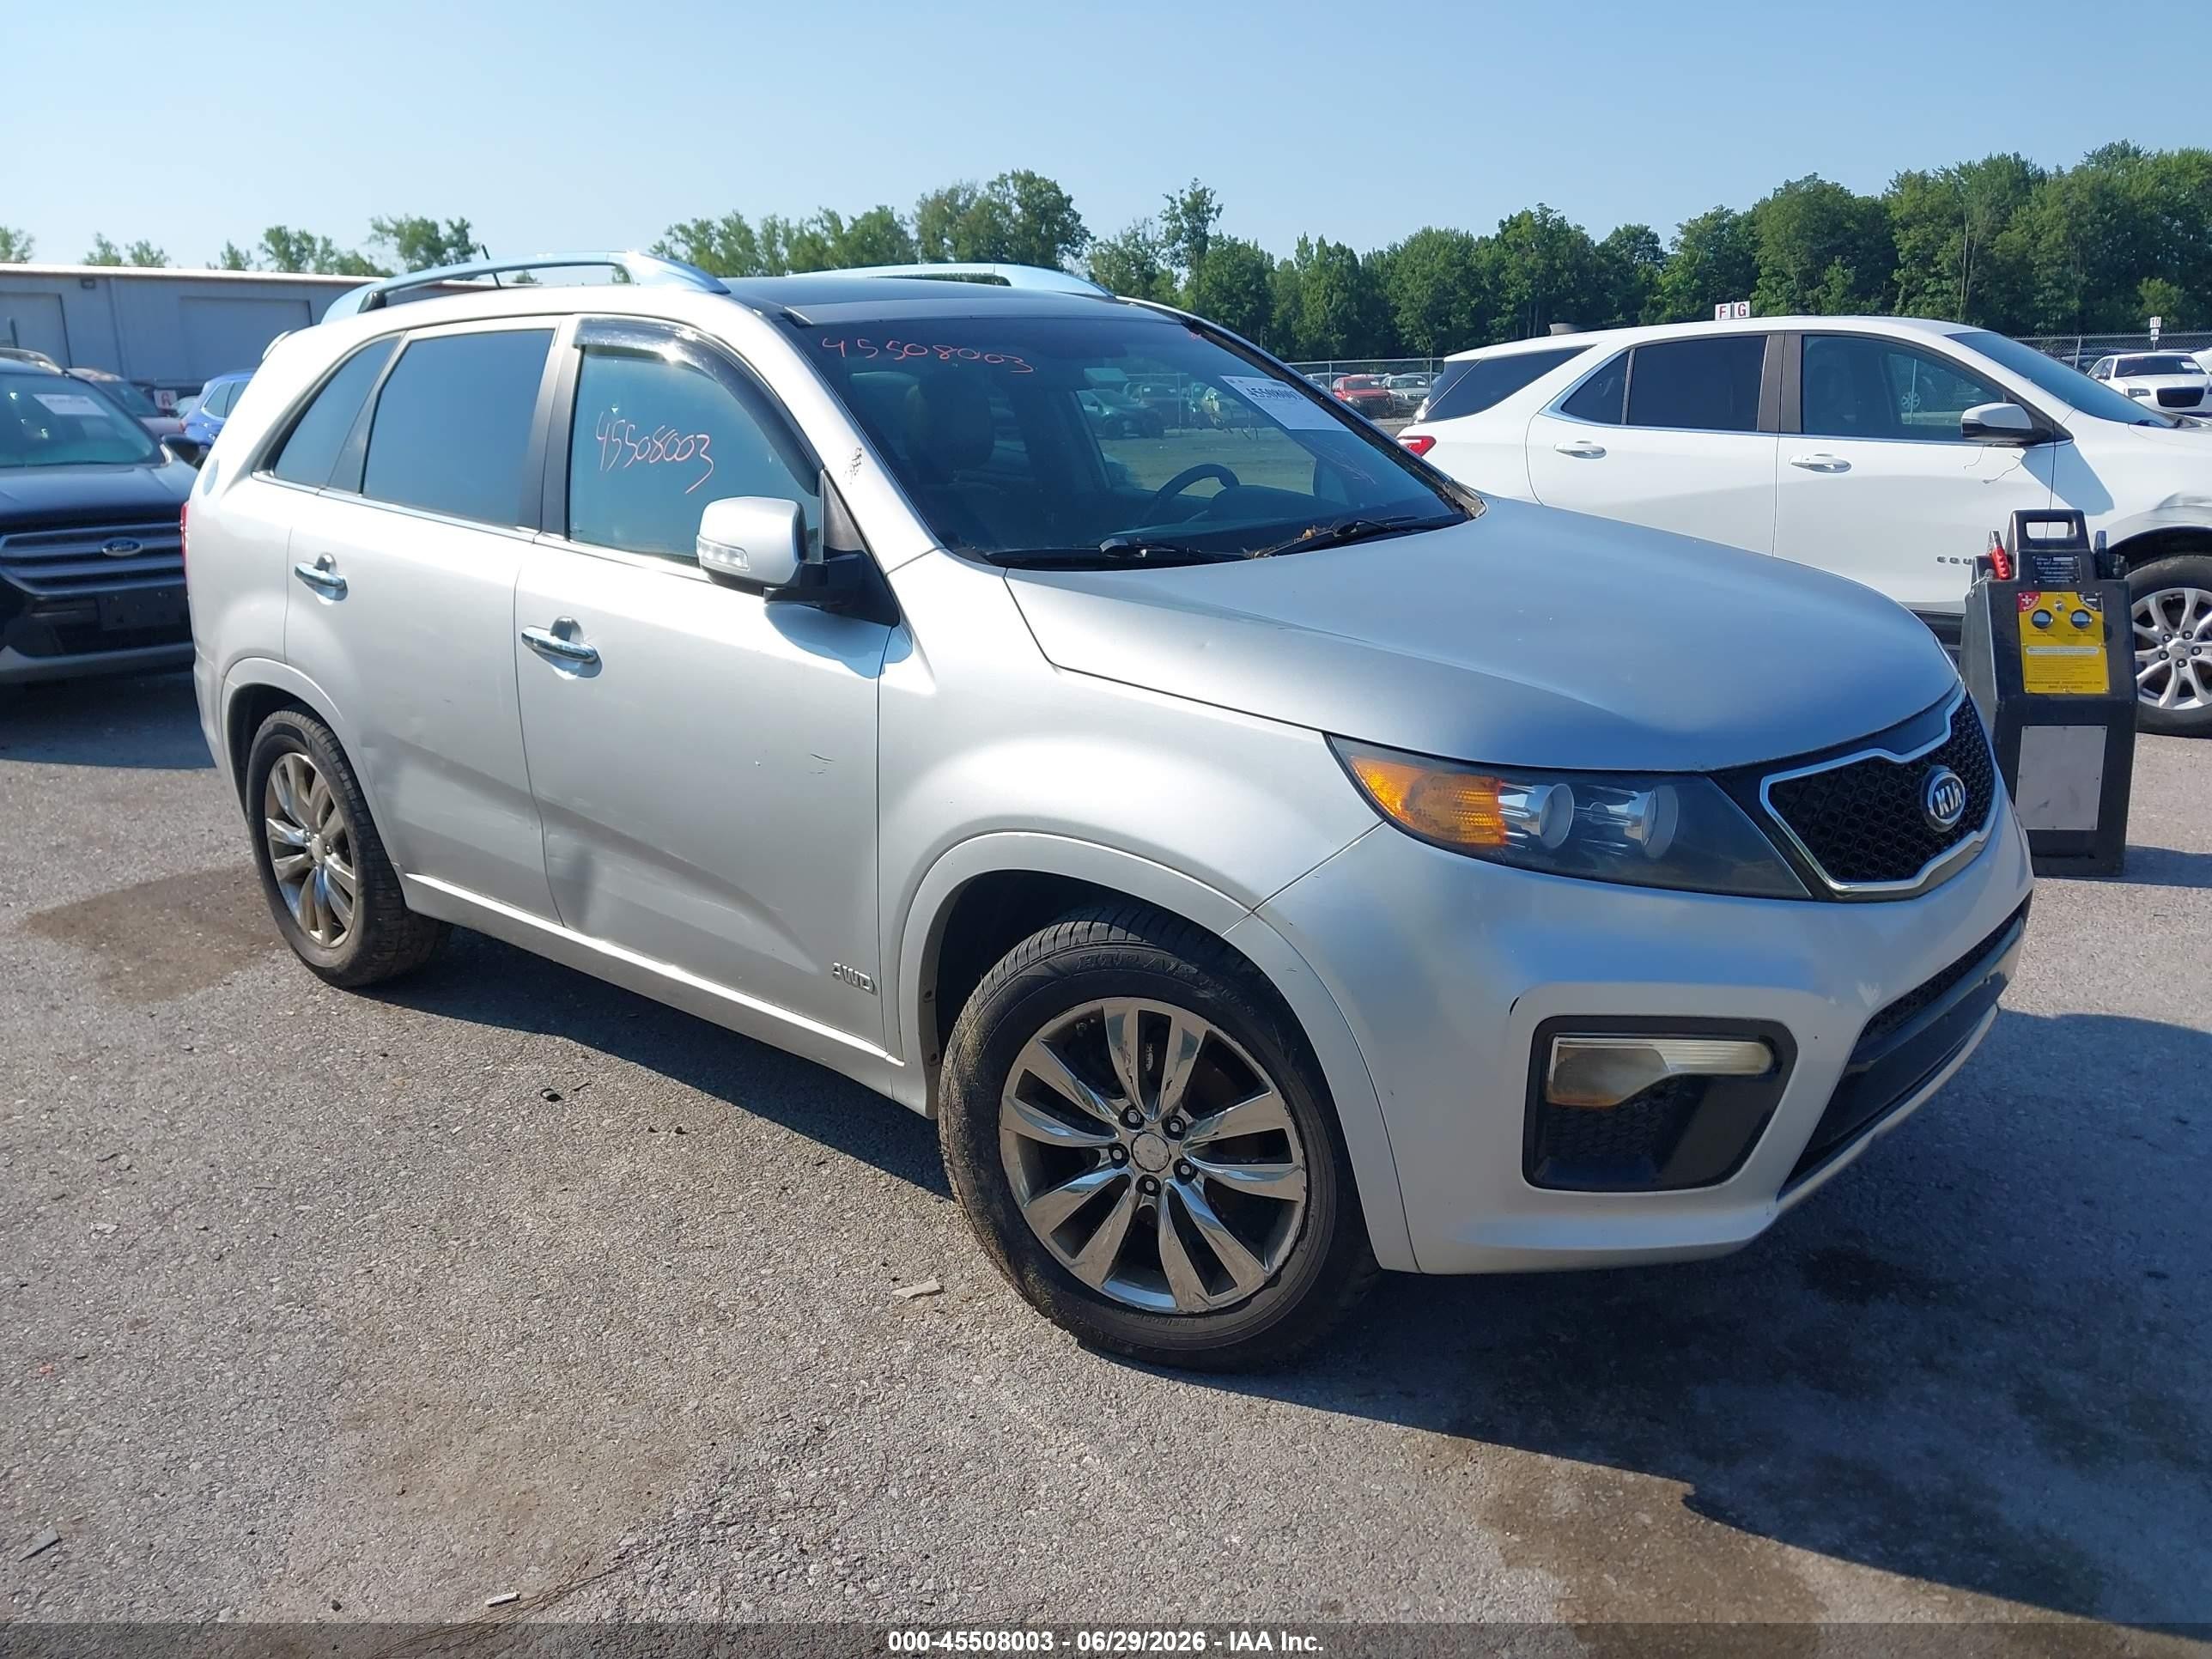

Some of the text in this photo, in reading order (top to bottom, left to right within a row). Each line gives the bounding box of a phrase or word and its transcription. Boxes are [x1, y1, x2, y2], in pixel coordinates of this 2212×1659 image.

[1719, 303, 1747, 319] F G
[822, 337, 1035, 373] 45508003
[596, 411, 714, 494] 45508003
[1935, 781, 1962, 816] KIA
[831, 962, 878, 996] AWD
